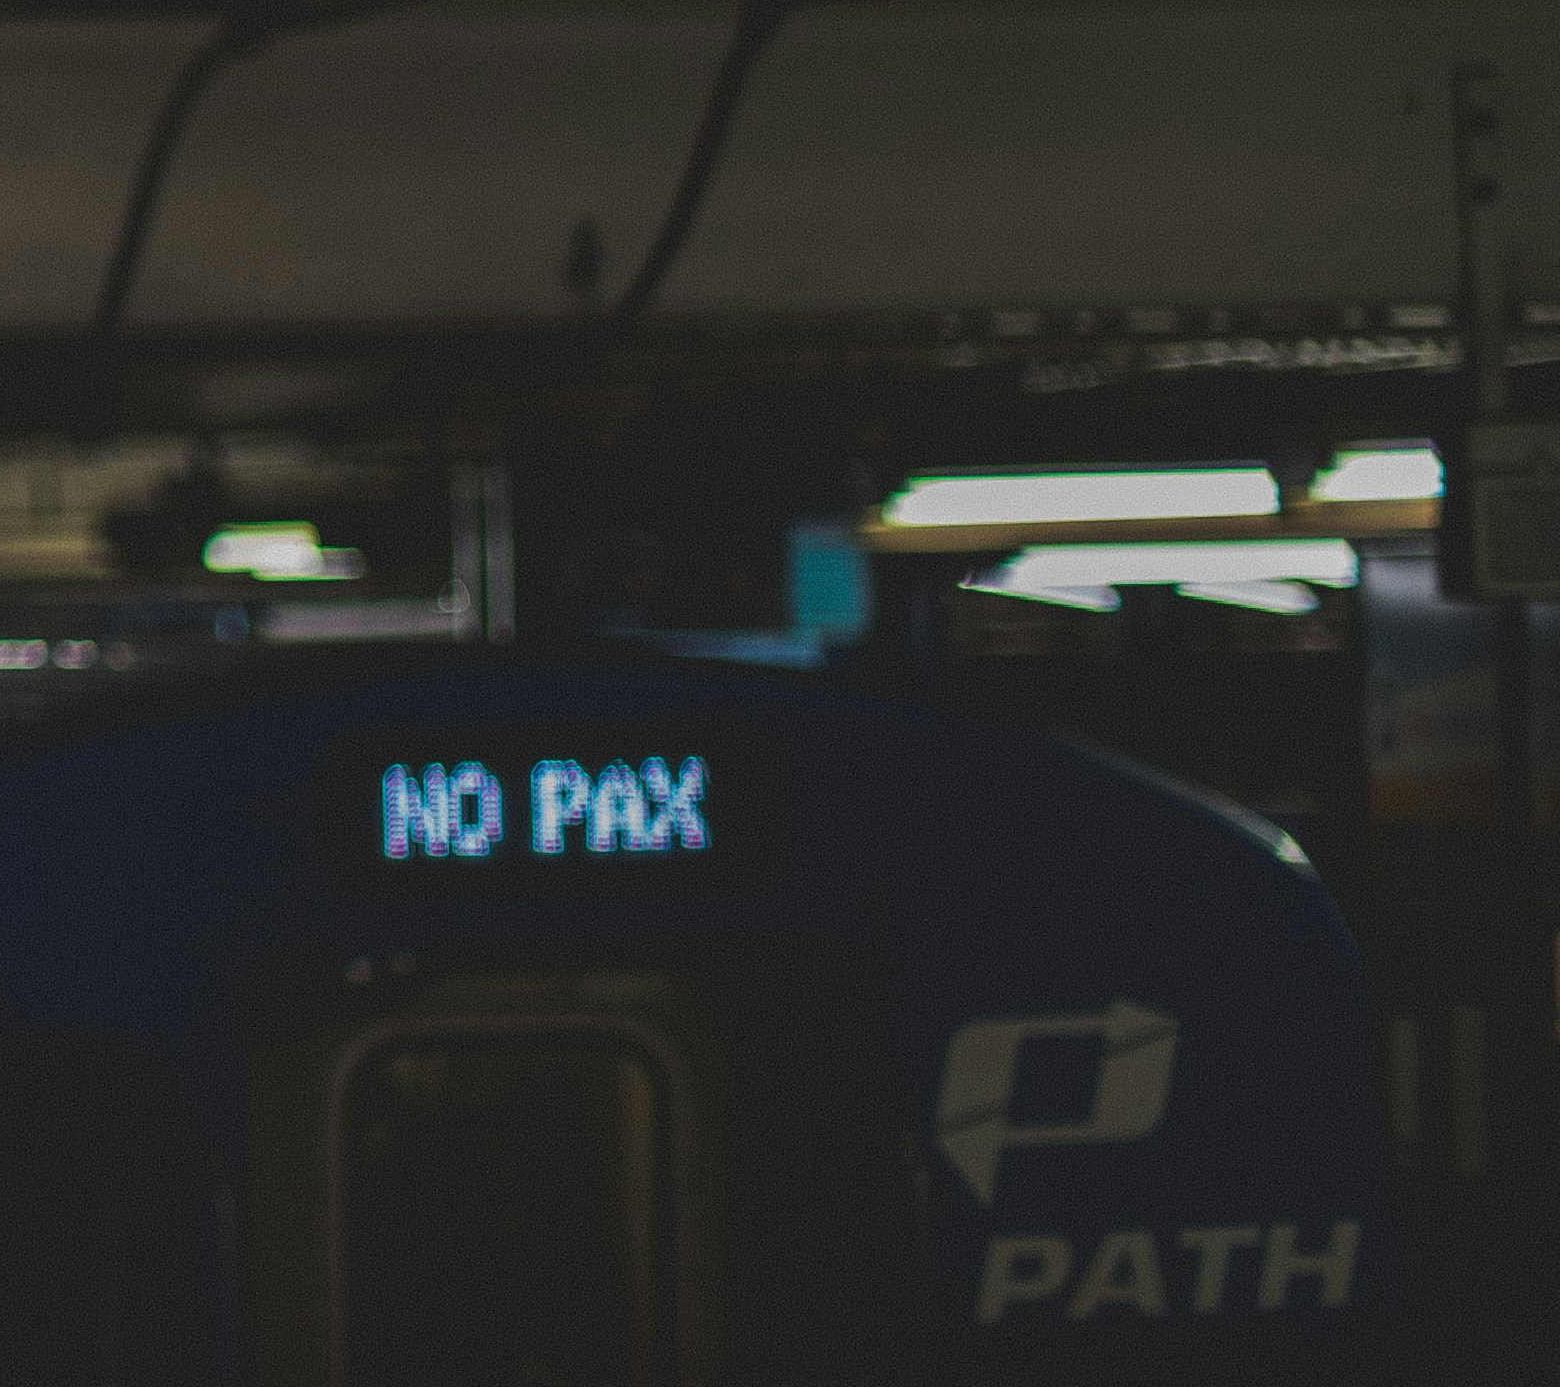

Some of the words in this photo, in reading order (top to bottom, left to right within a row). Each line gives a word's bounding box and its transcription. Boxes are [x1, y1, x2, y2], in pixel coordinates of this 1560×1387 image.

[380, 759, 505, 859] NO
[530, 754, 710, 855] PAX
[975, 1221, 1362, 1325] PATH
